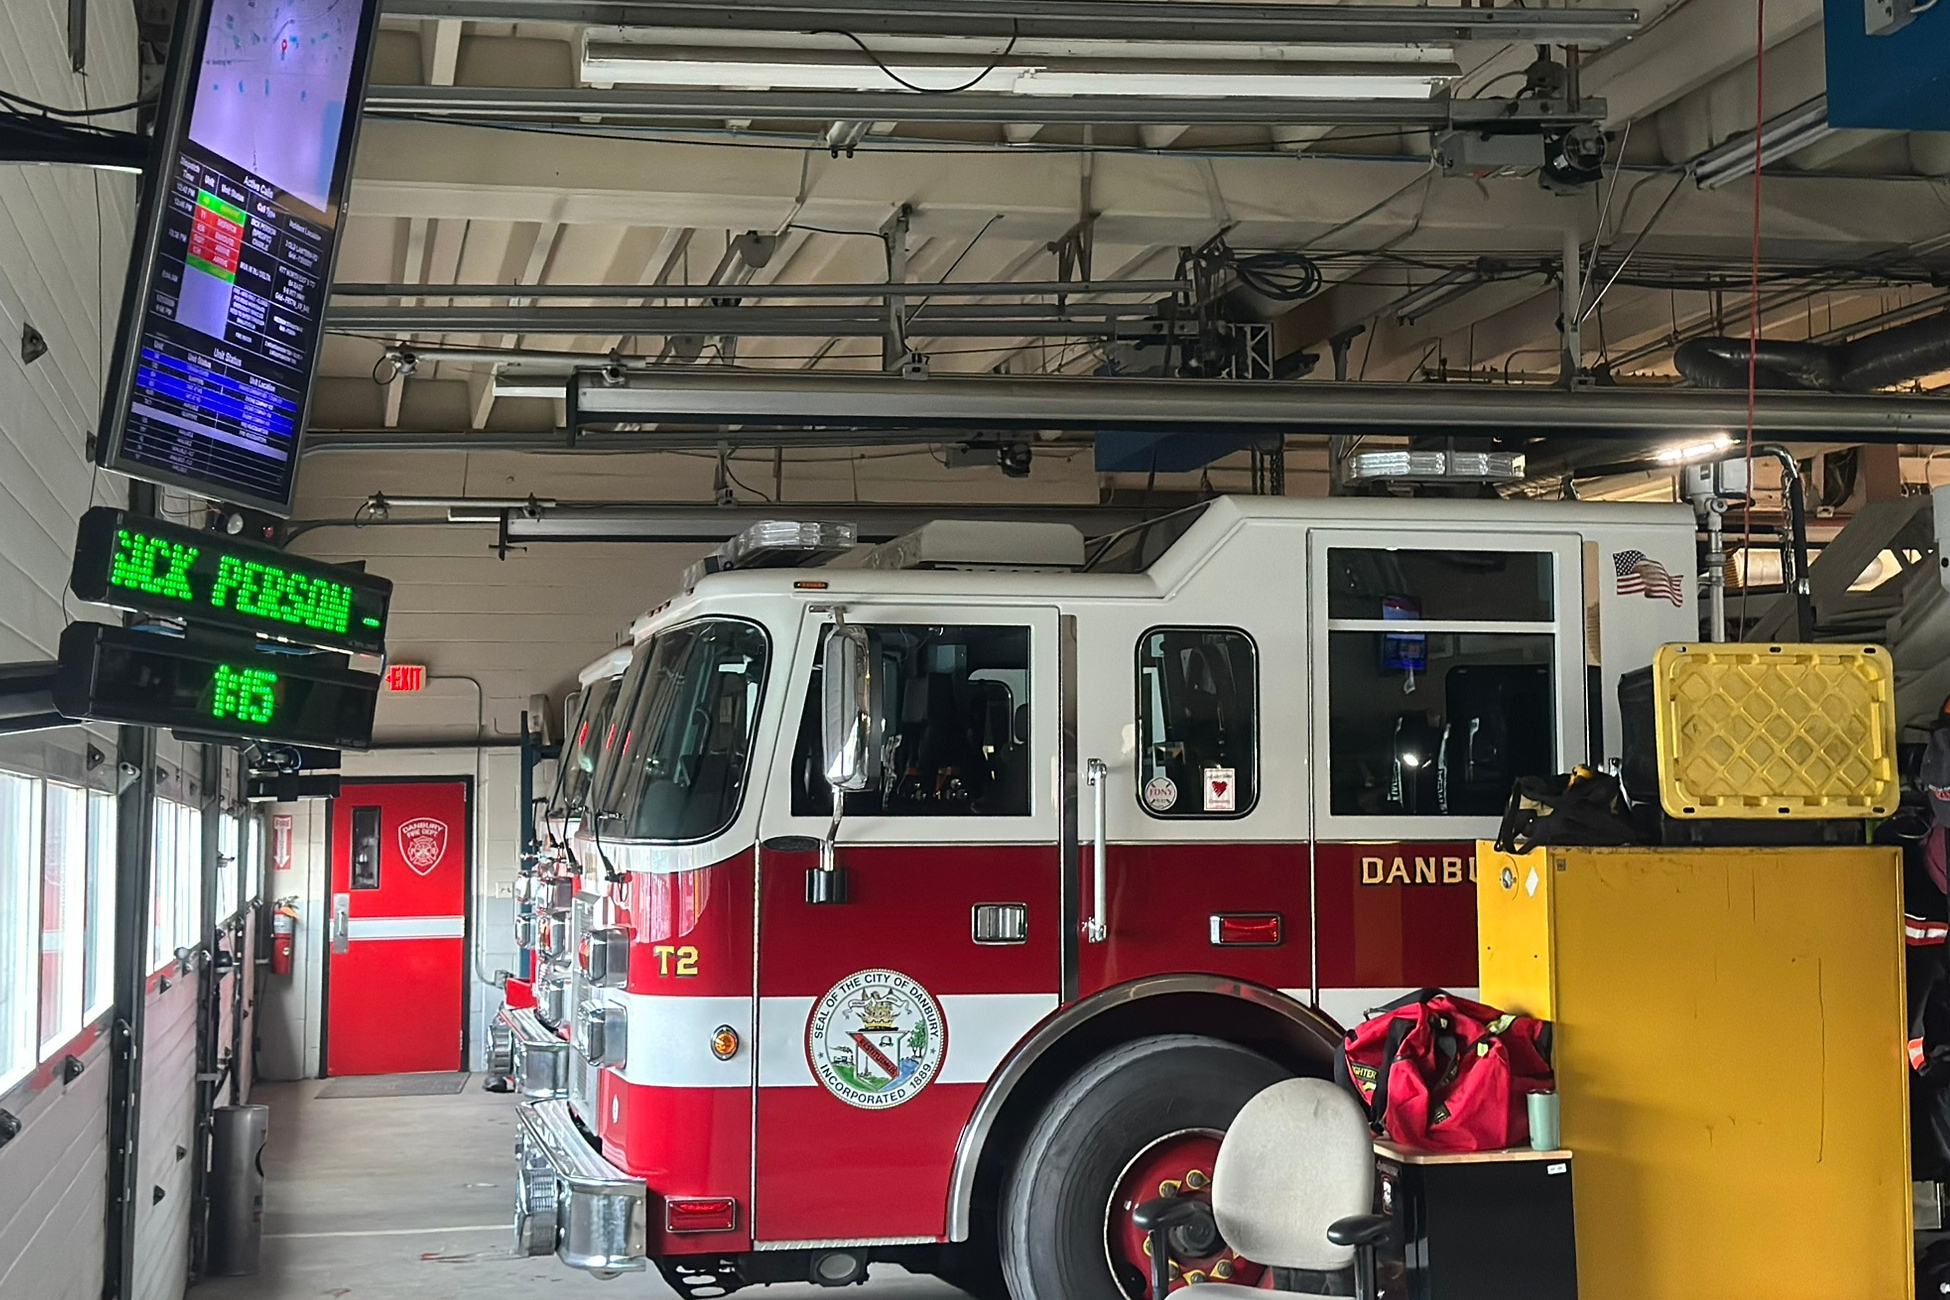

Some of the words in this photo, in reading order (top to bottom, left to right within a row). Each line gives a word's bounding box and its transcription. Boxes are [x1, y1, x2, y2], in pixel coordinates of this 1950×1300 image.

[204, 174, 215, 188] Unit
[243, 175, 260, 192] Active
[260, 184, 274, 199] Calls
[256, 202, 266, 213] Call
[265, 206, 276, 219] Type
[214, 348, 225, 360] Unit
[225, 352, 242, 367] Status
[211, 554, 353, 633] PERSON
[390, 665, 423, 691] EXIT
[1149, 788, 1172, 797] FDNY
[275, 820, 290, 828] FIRE
[402, 822, 444, 834] DANBURY
[406, 829, 421, 838] FIRE
[653, 945, 698, 976] T2
[814, 1010, 830, 1039] SEAL
[826, 992, 839, 1008] OF
[839, 977, 861, 994] THE
[864, 973, 891, 984] CITY
[893, 977, 910, 989] OF
[820, 1064, 906, 1104] INCORPORATED
